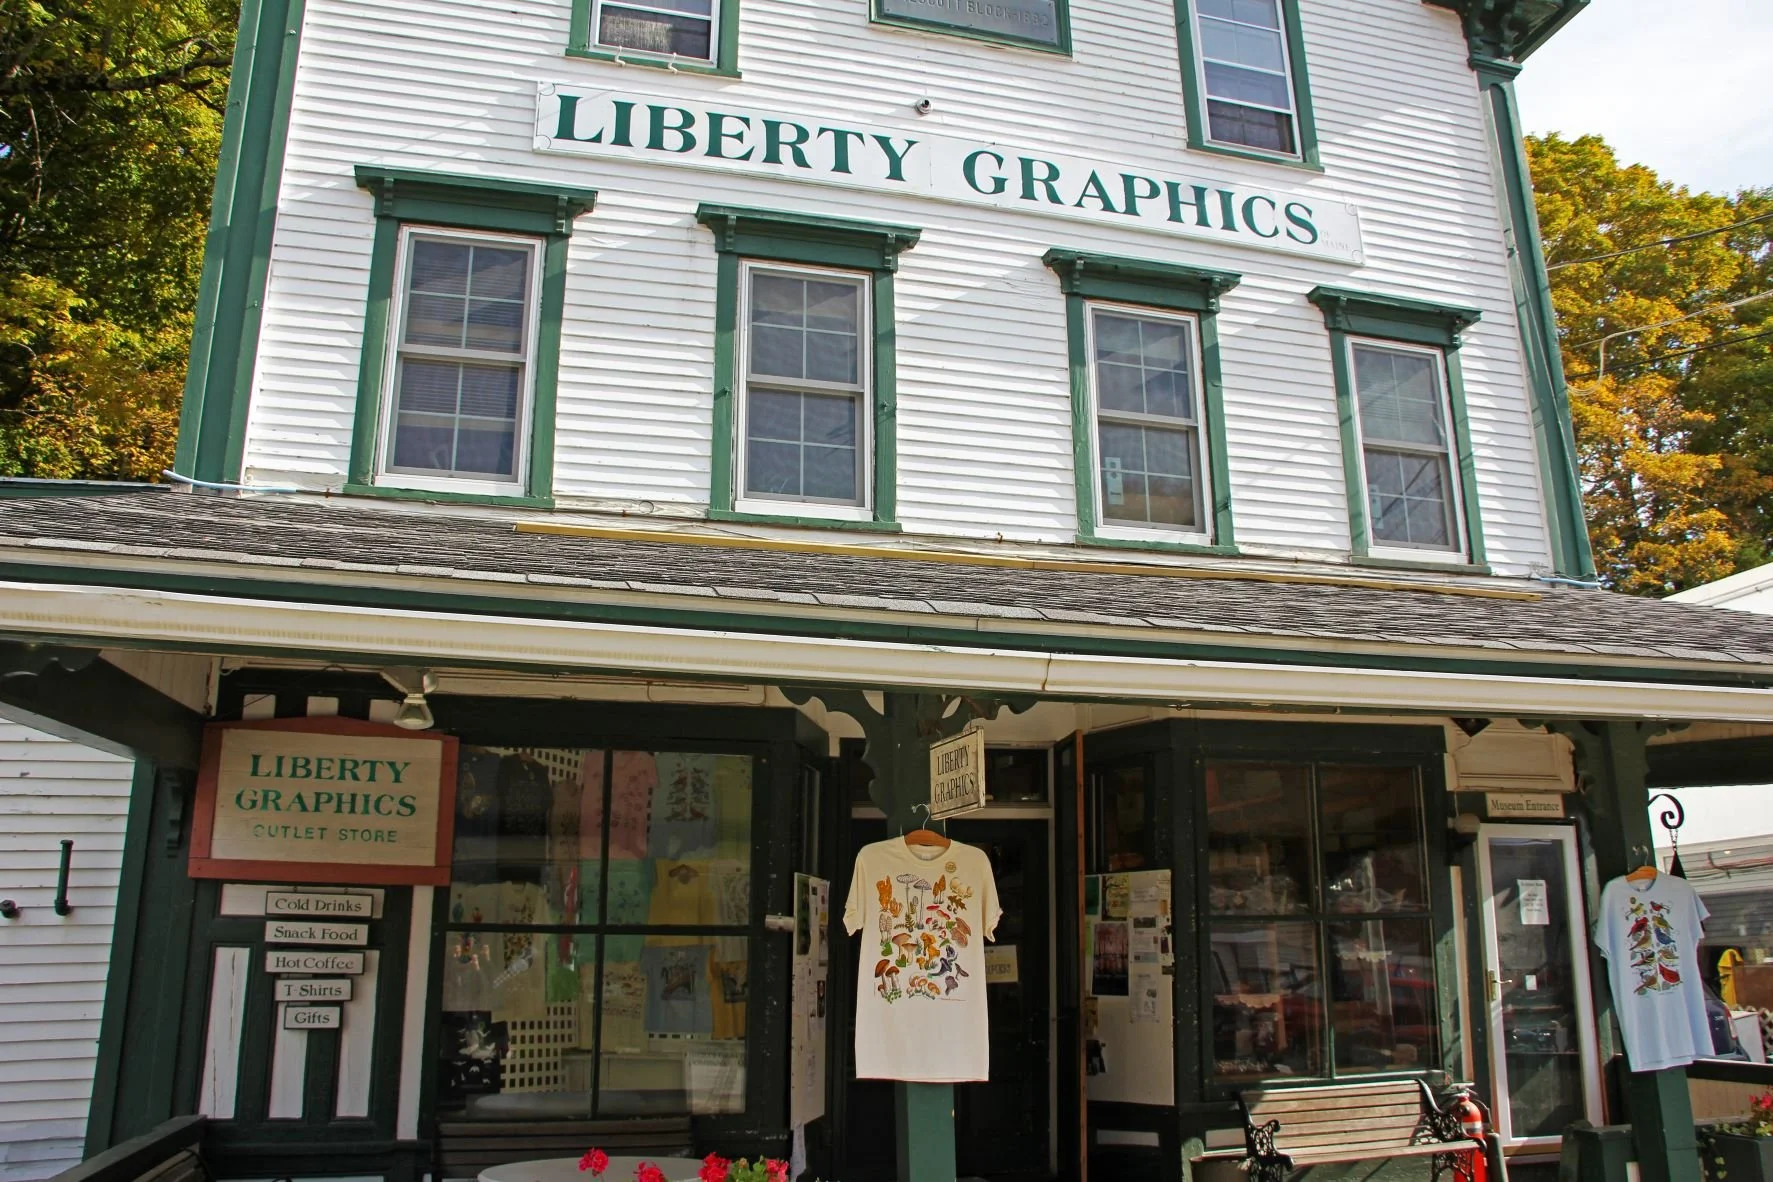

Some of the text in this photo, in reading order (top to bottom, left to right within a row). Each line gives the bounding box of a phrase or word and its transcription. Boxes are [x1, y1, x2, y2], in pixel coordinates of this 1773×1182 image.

[552, 94, 1319, 245] LIBERTY GRAPHICS
[250, 754, 411, 784] LIBERTY
[937, 745, 970, 776] LIBERTY
[934, 772, 976, 804] GRAPHICS
[235, 788, 417, 817] GRAPHICS
[1491, 799, 1560, 812] Museum Entrance
[254, 824, 398, 843] OUTLET STORE
[275, 898, 362, 913] Cold Drinks
[273, 925, 358, 941] Snack Food
[275, 956, 354, 970] Hot Coffee
[284, 984, 342, 997] T-Shirts
[294, 1011, 330, 1024] Gifts
